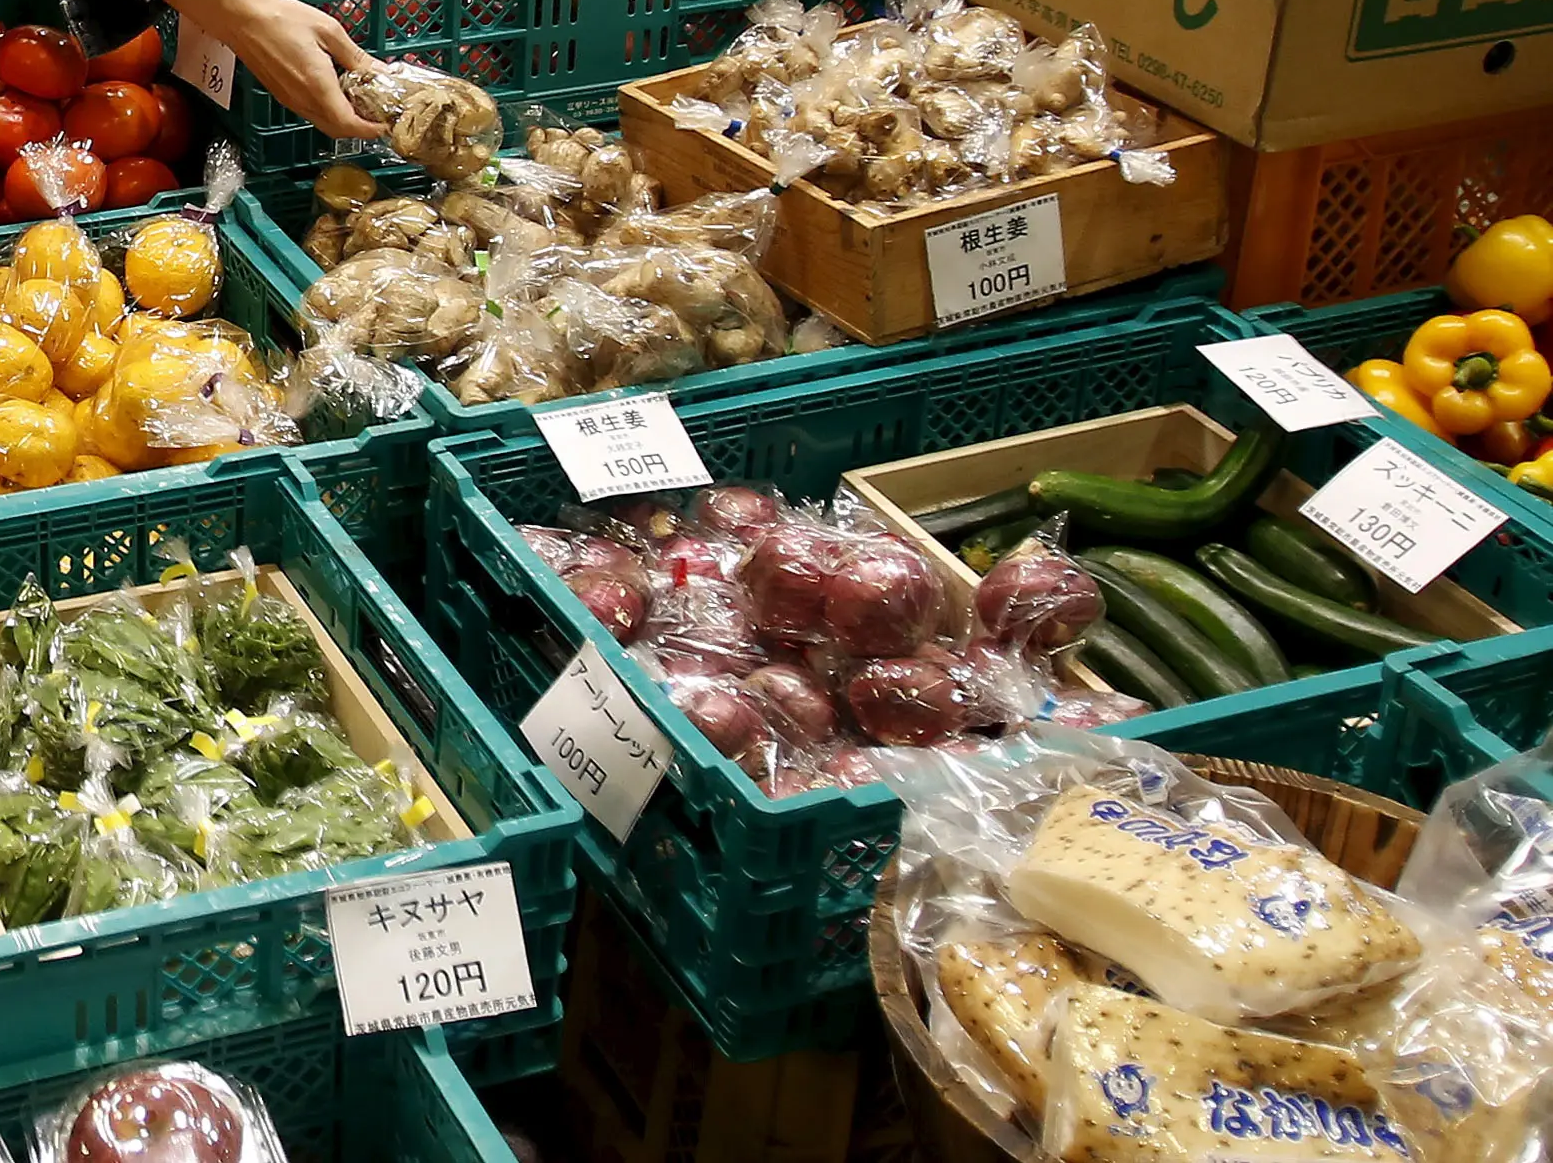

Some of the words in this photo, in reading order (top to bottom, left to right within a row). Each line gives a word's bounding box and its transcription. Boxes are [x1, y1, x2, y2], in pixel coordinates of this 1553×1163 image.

[1110, 38, 1134, 66] TEL
[960, 215, 1029, 254] 根生姜
[968, 264, 1031, 300] 100円
[1238, 366, 1299, 405] 120円
[575, 408, 649, 437] 根生姜
[602, 453, 669, 479] 150円
[1373, 460, 1476, 531] ズッキーニ
[1348, 507, 1417, 560] 130円
[551, 726, 607, 796] 100円
[367, 890, 485, 933] キヌサヤ
[408, 941, 463, 962] 後藤文男
[399, 960, 487, 1004] 120円
